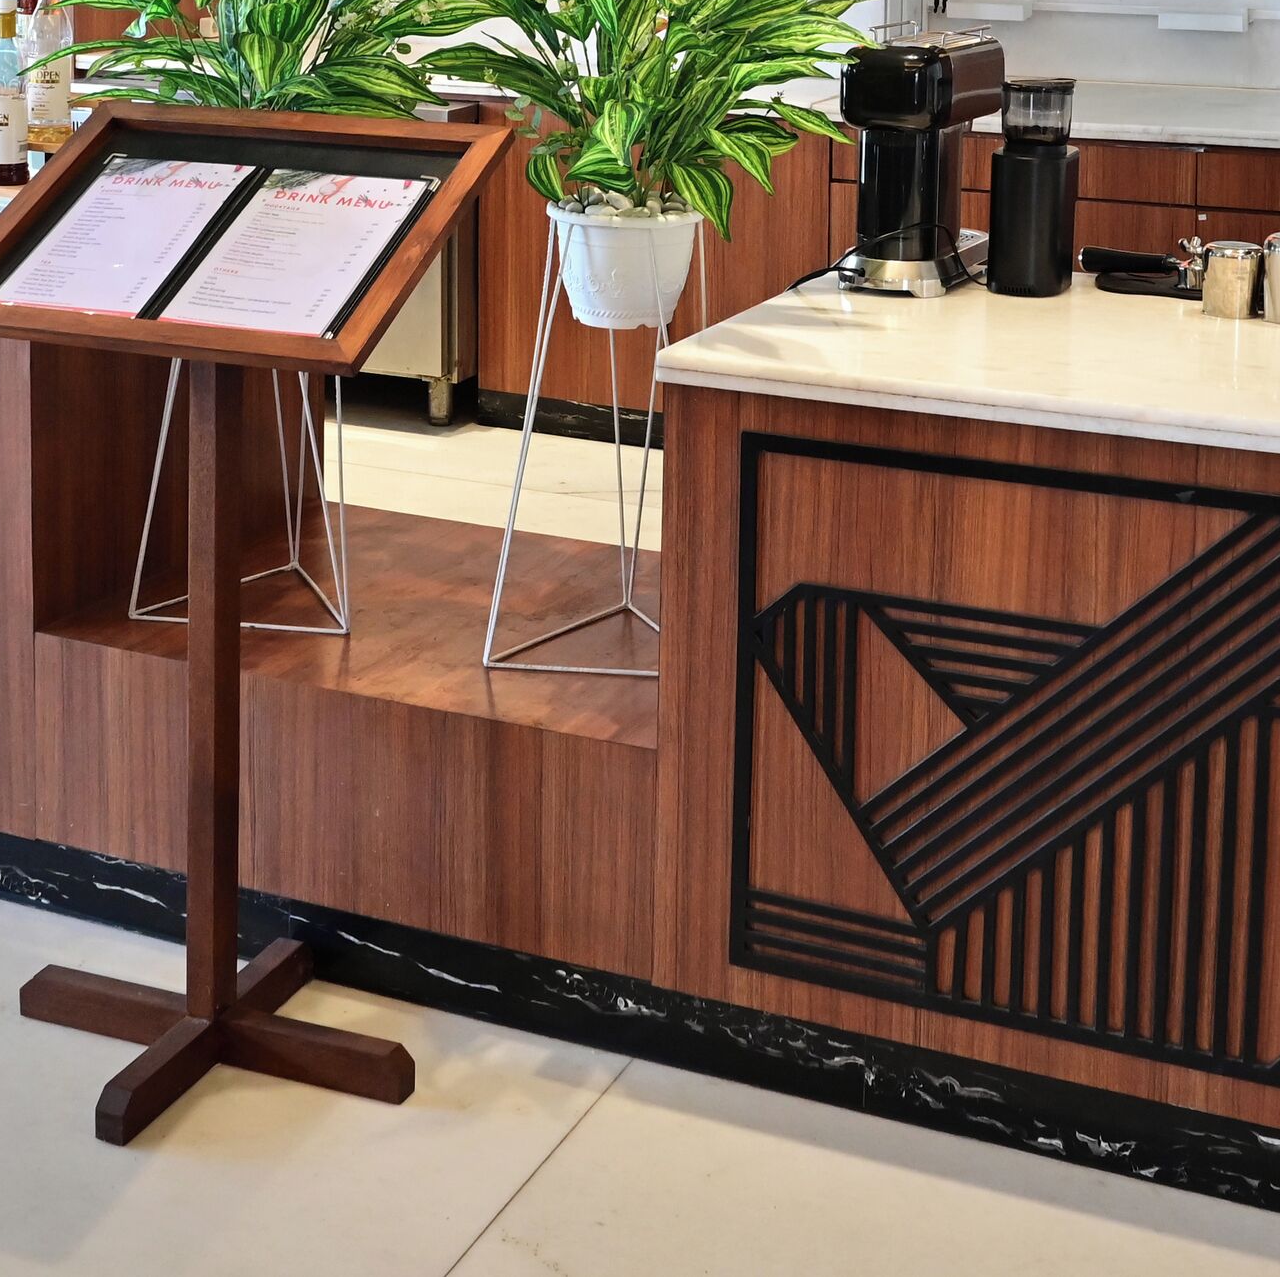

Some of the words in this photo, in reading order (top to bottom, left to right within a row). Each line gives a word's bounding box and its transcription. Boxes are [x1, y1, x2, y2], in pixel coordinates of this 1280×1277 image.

[112, 175, 165, 187] DRINK
[170, 179, 220, 190] MENU
[274, 190, 331, 204] DRINK
[336, 197, 391, 210] MENU
